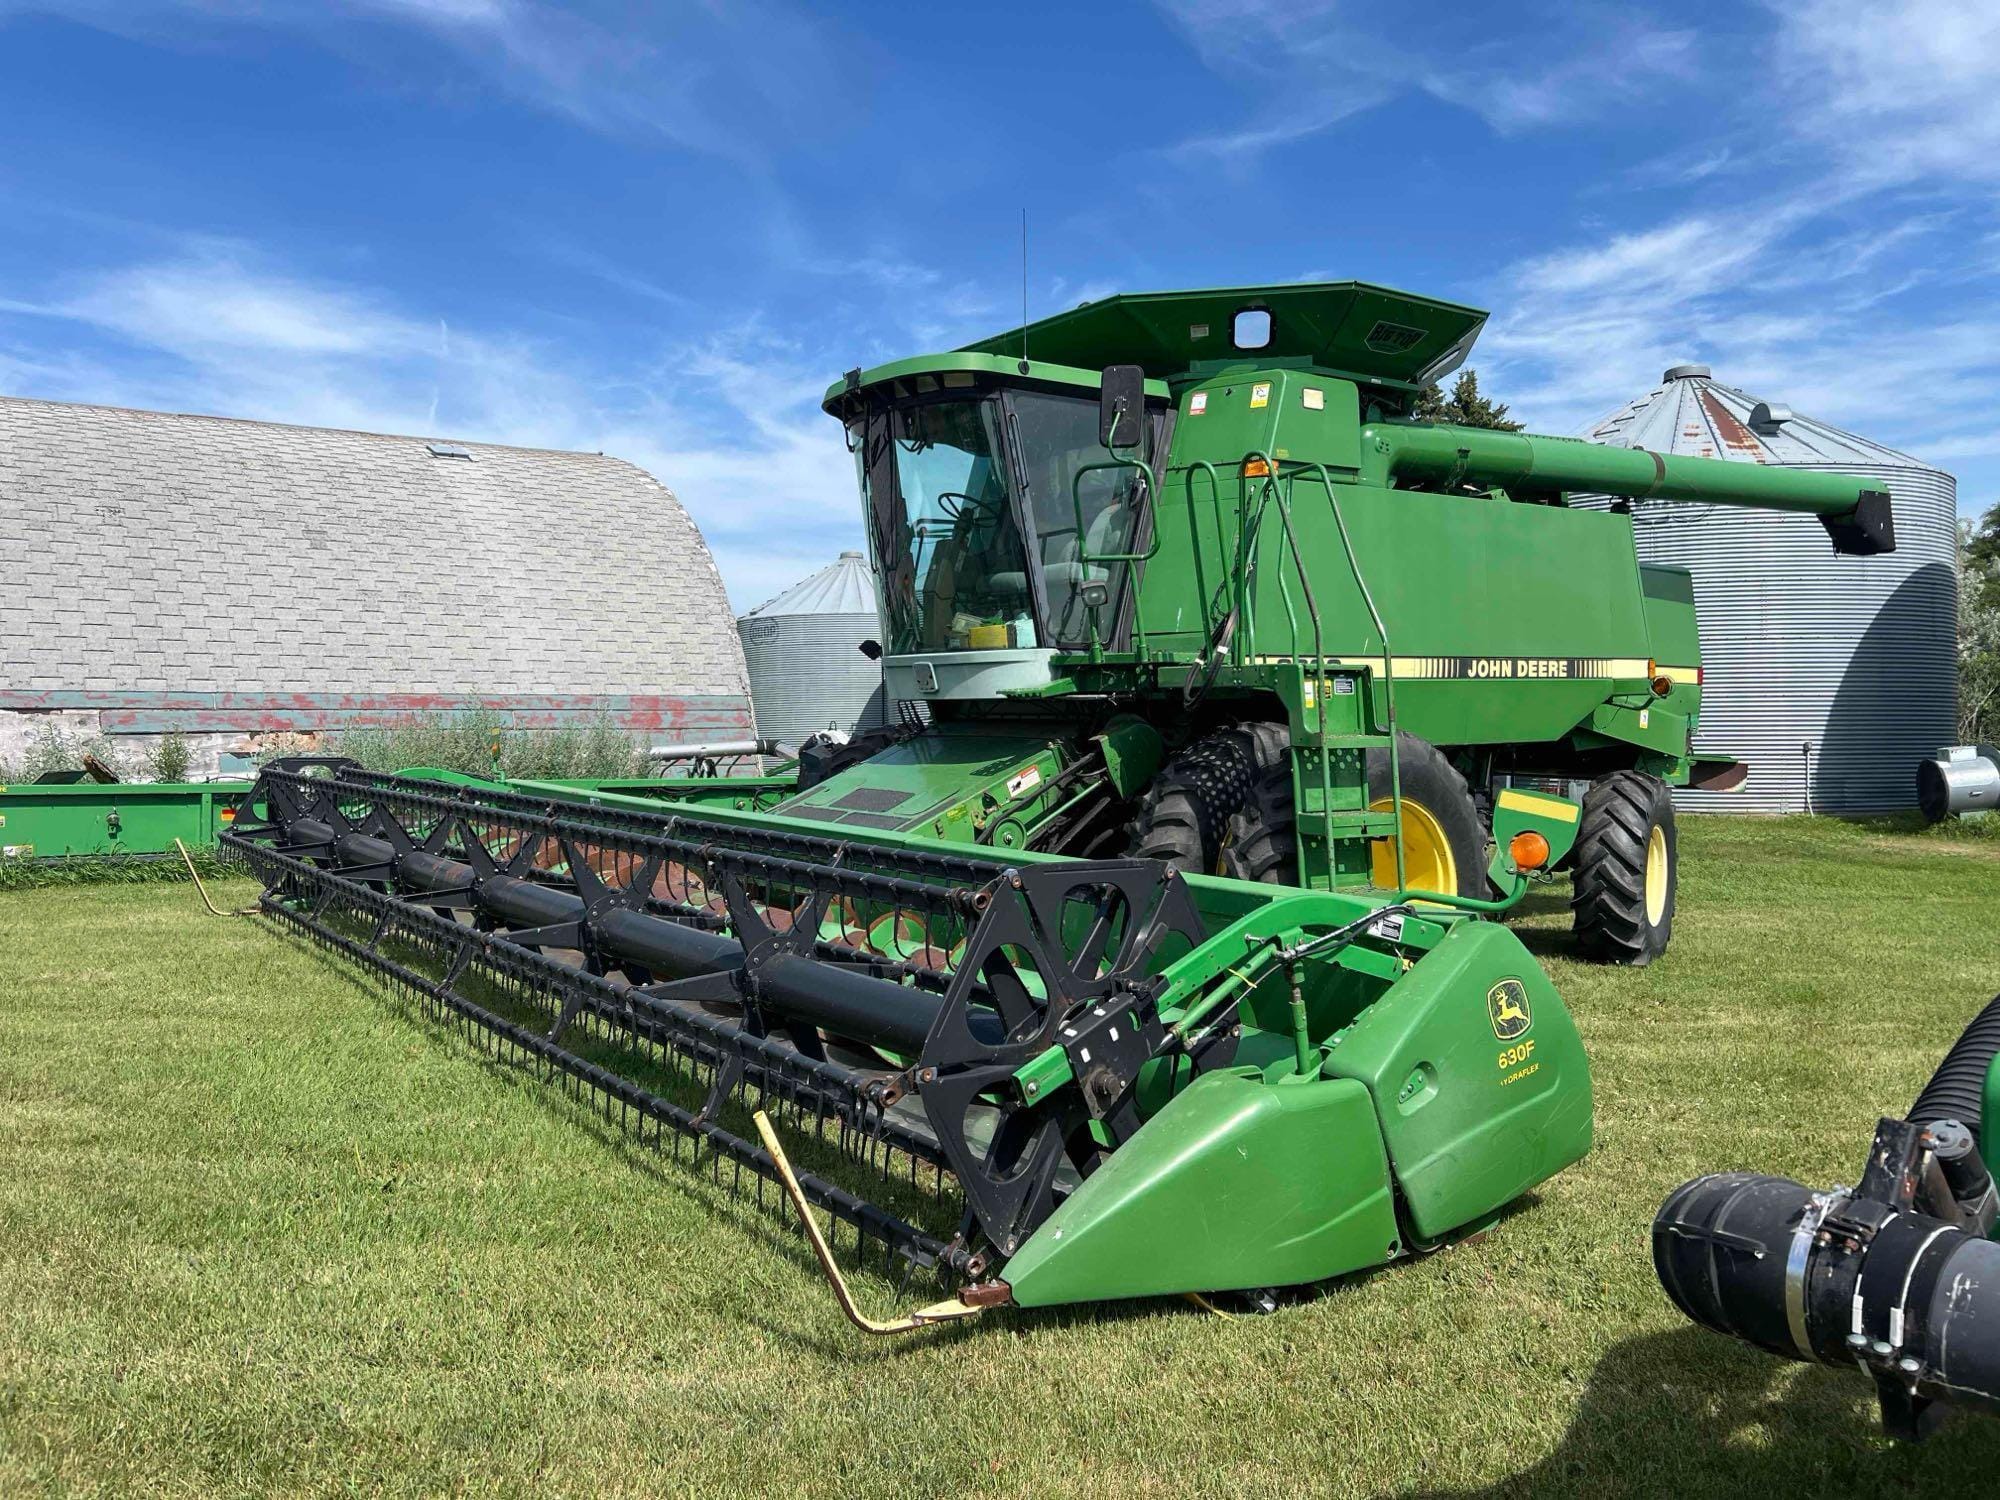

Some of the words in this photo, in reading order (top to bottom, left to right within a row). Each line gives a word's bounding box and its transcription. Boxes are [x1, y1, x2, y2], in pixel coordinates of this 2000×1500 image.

[1467, 659, 1512, 678] JOHN
[1517, 660, 1568, 678] DEERE
[1498, 1039, 1535, 1069] 630F
[1500, 1063, 1540, 1087] YDRAFLEX
